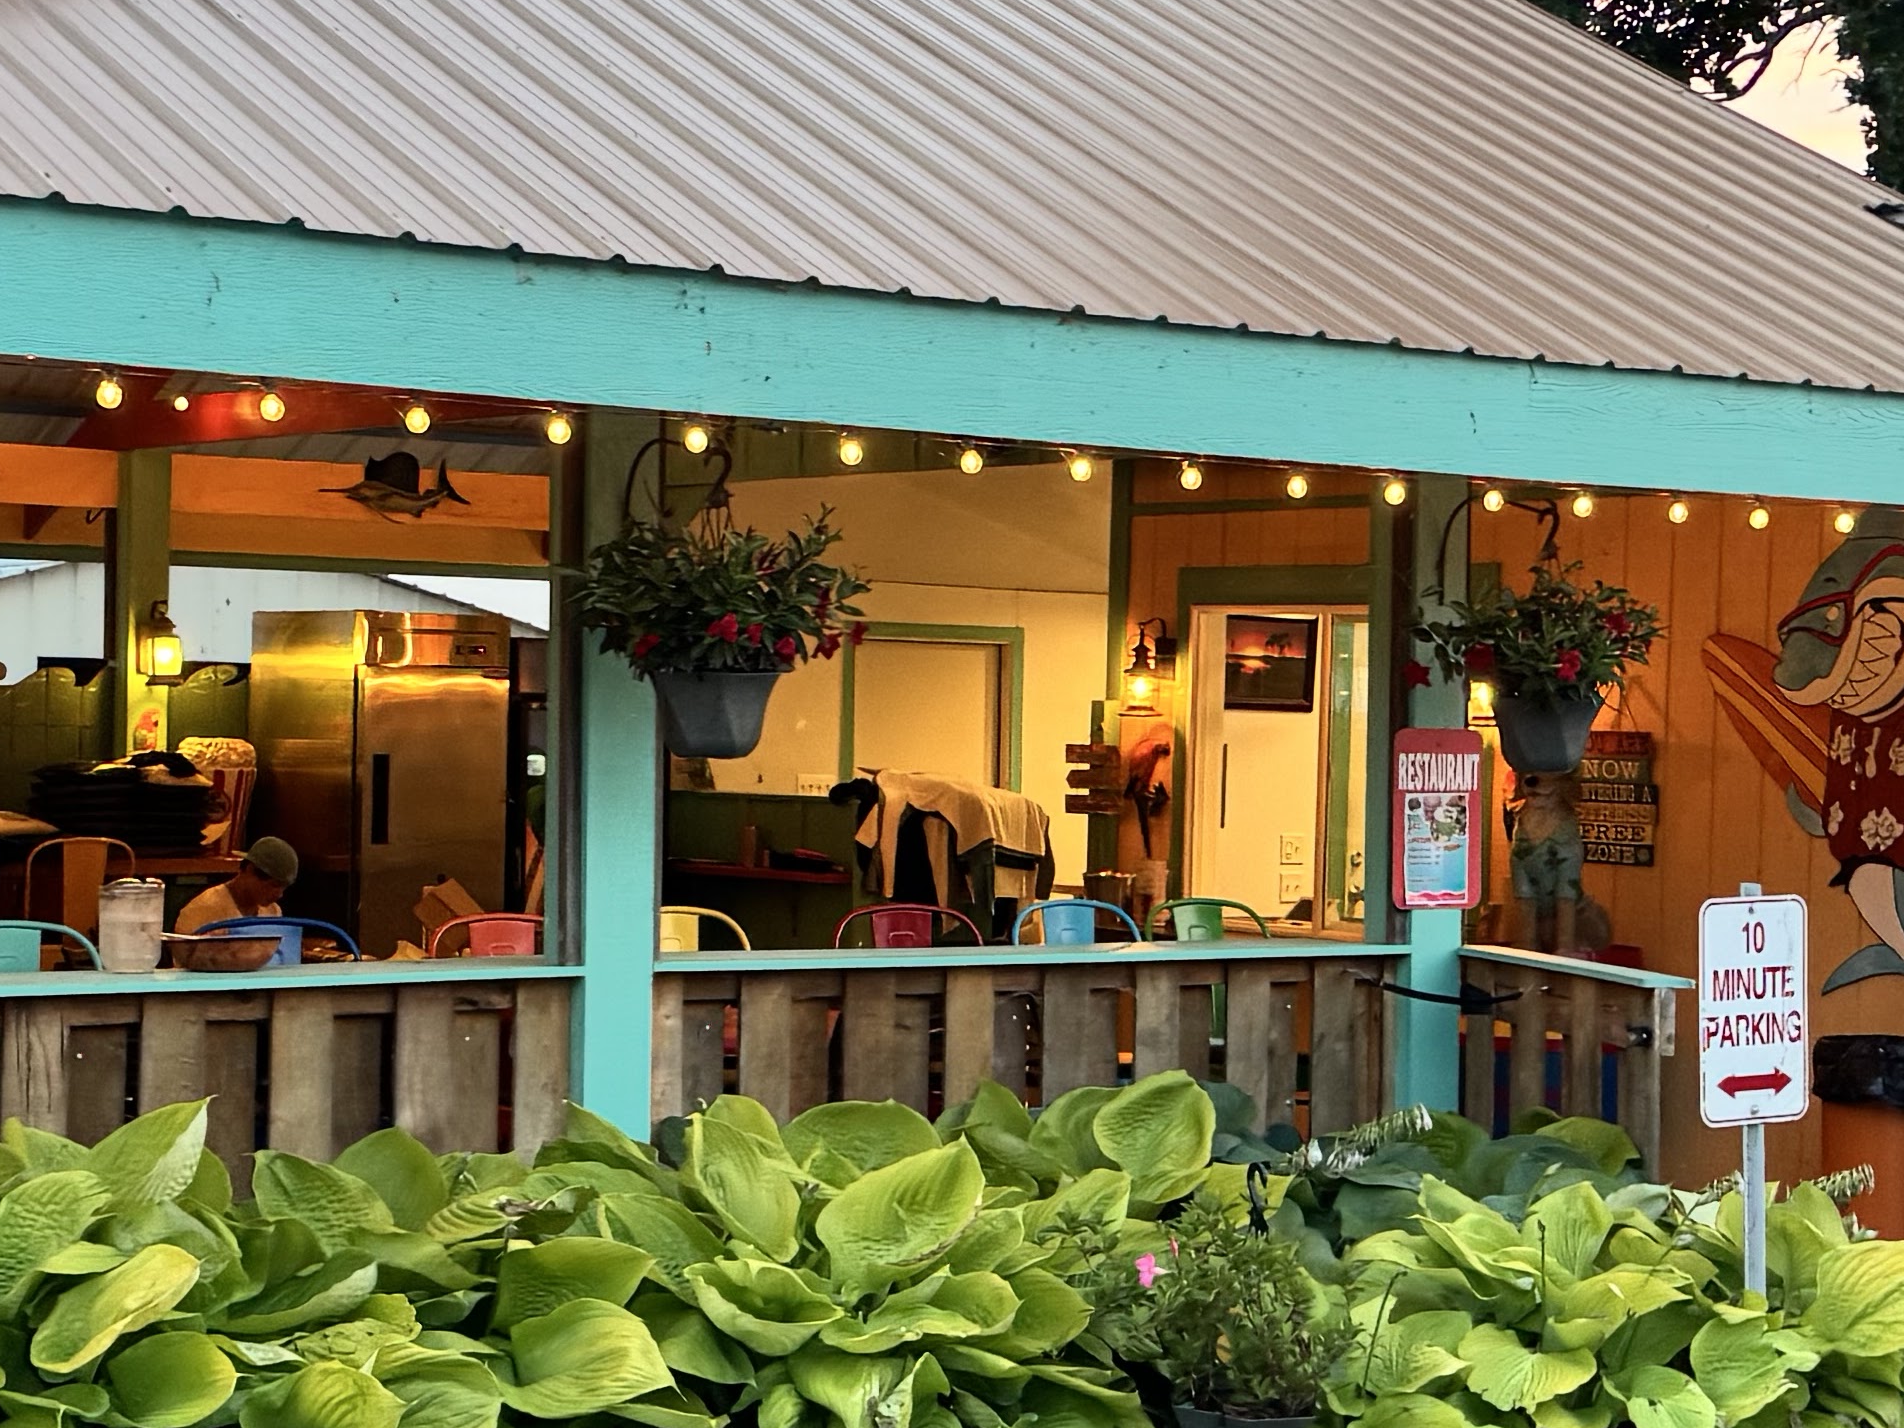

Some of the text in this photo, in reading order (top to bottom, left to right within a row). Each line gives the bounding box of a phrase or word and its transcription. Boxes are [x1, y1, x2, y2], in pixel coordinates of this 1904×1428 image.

[1398, 752, 1481, 792] RESTAURANT
[1581, 758, 1640, 780] NOW
[1642, 784, 1652, 803] A
[1580, 824, 1646, 842] FREE
[1586, 844, 1636, 864] ZONE
[1742, 921, 1765, 954] 10
[1712, 965, 1795, 1002] MINUTE
[1703, 1010, 1801, 1052] PARKING
